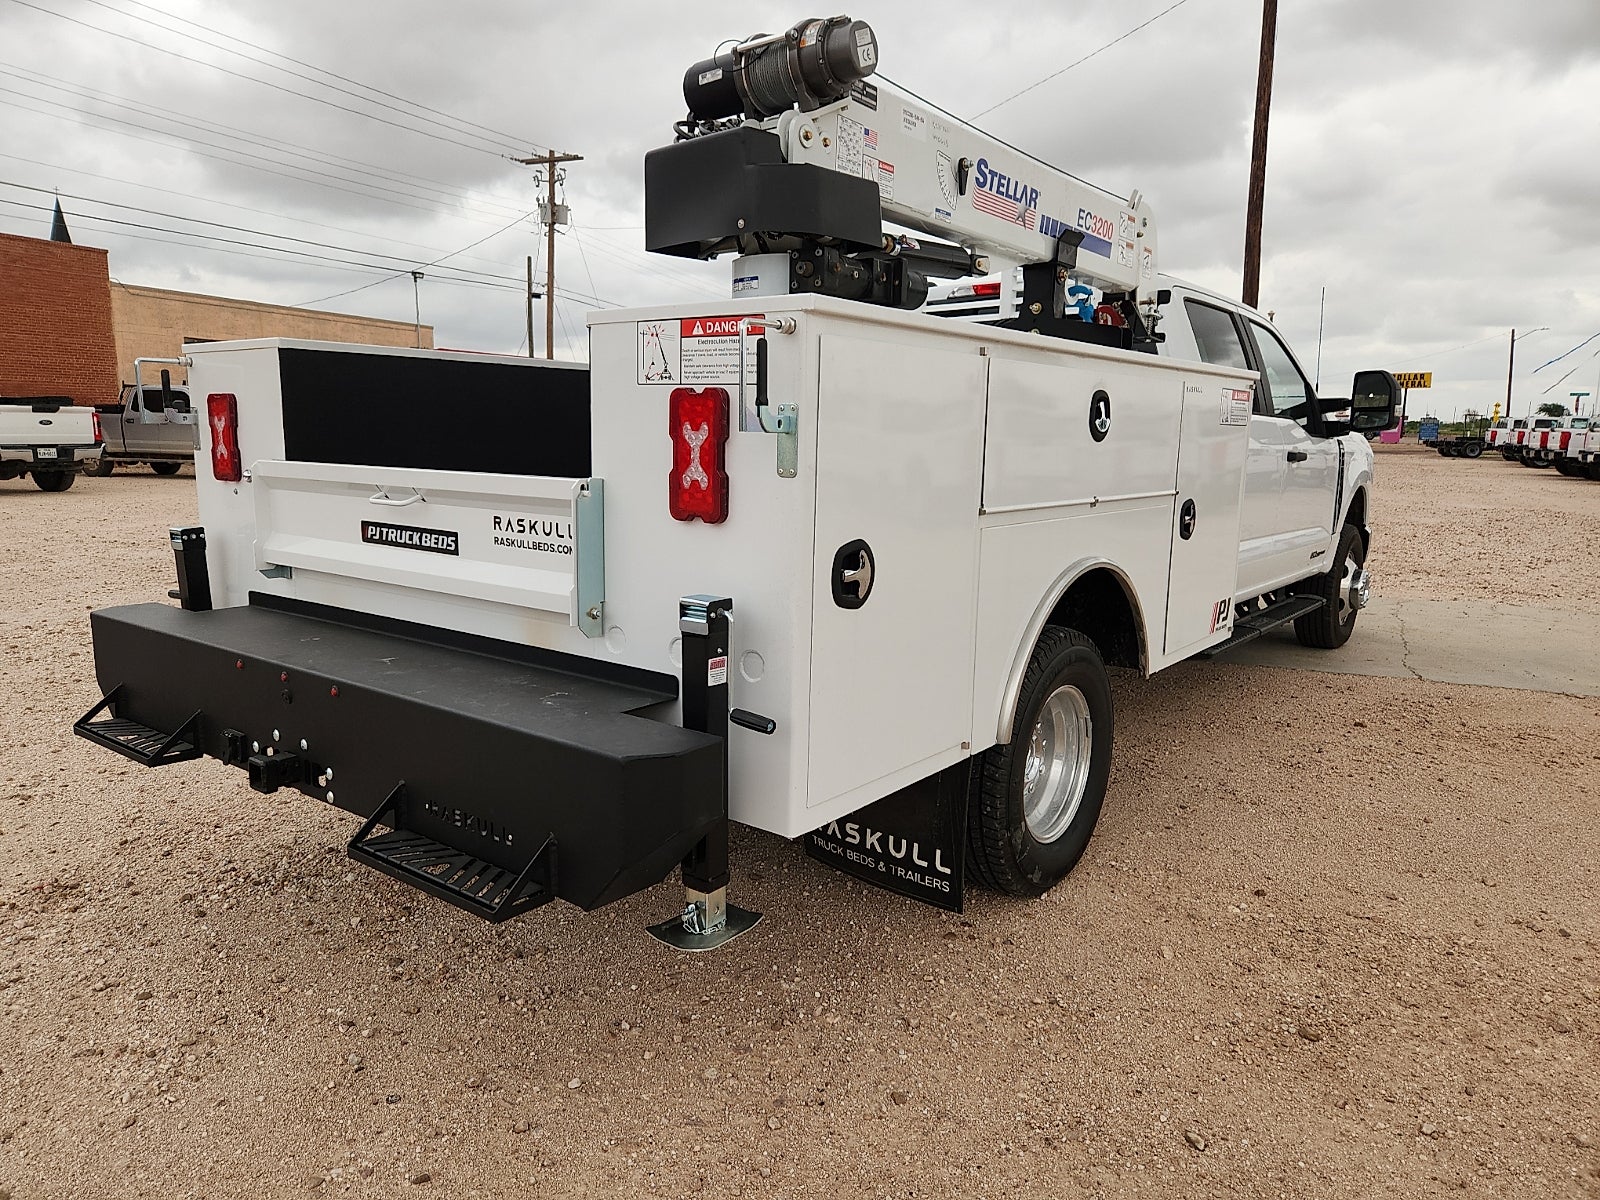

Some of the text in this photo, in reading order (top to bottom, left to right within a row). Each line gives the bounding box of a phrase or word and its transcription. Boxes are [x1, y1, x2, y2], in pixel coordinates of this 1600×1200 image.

[974, 157, 1039, 210] STELLAR
[1077, 208, 1114, 240] EC3200
[367, 526, 456, 550] PJ TRUCK BEDS
[1216, 597, 1231, 624] PJ
[812, 835, 950, 893] TRUCK BEDS & TRAILERS
[818, 820, 951, 875] ASKULL
